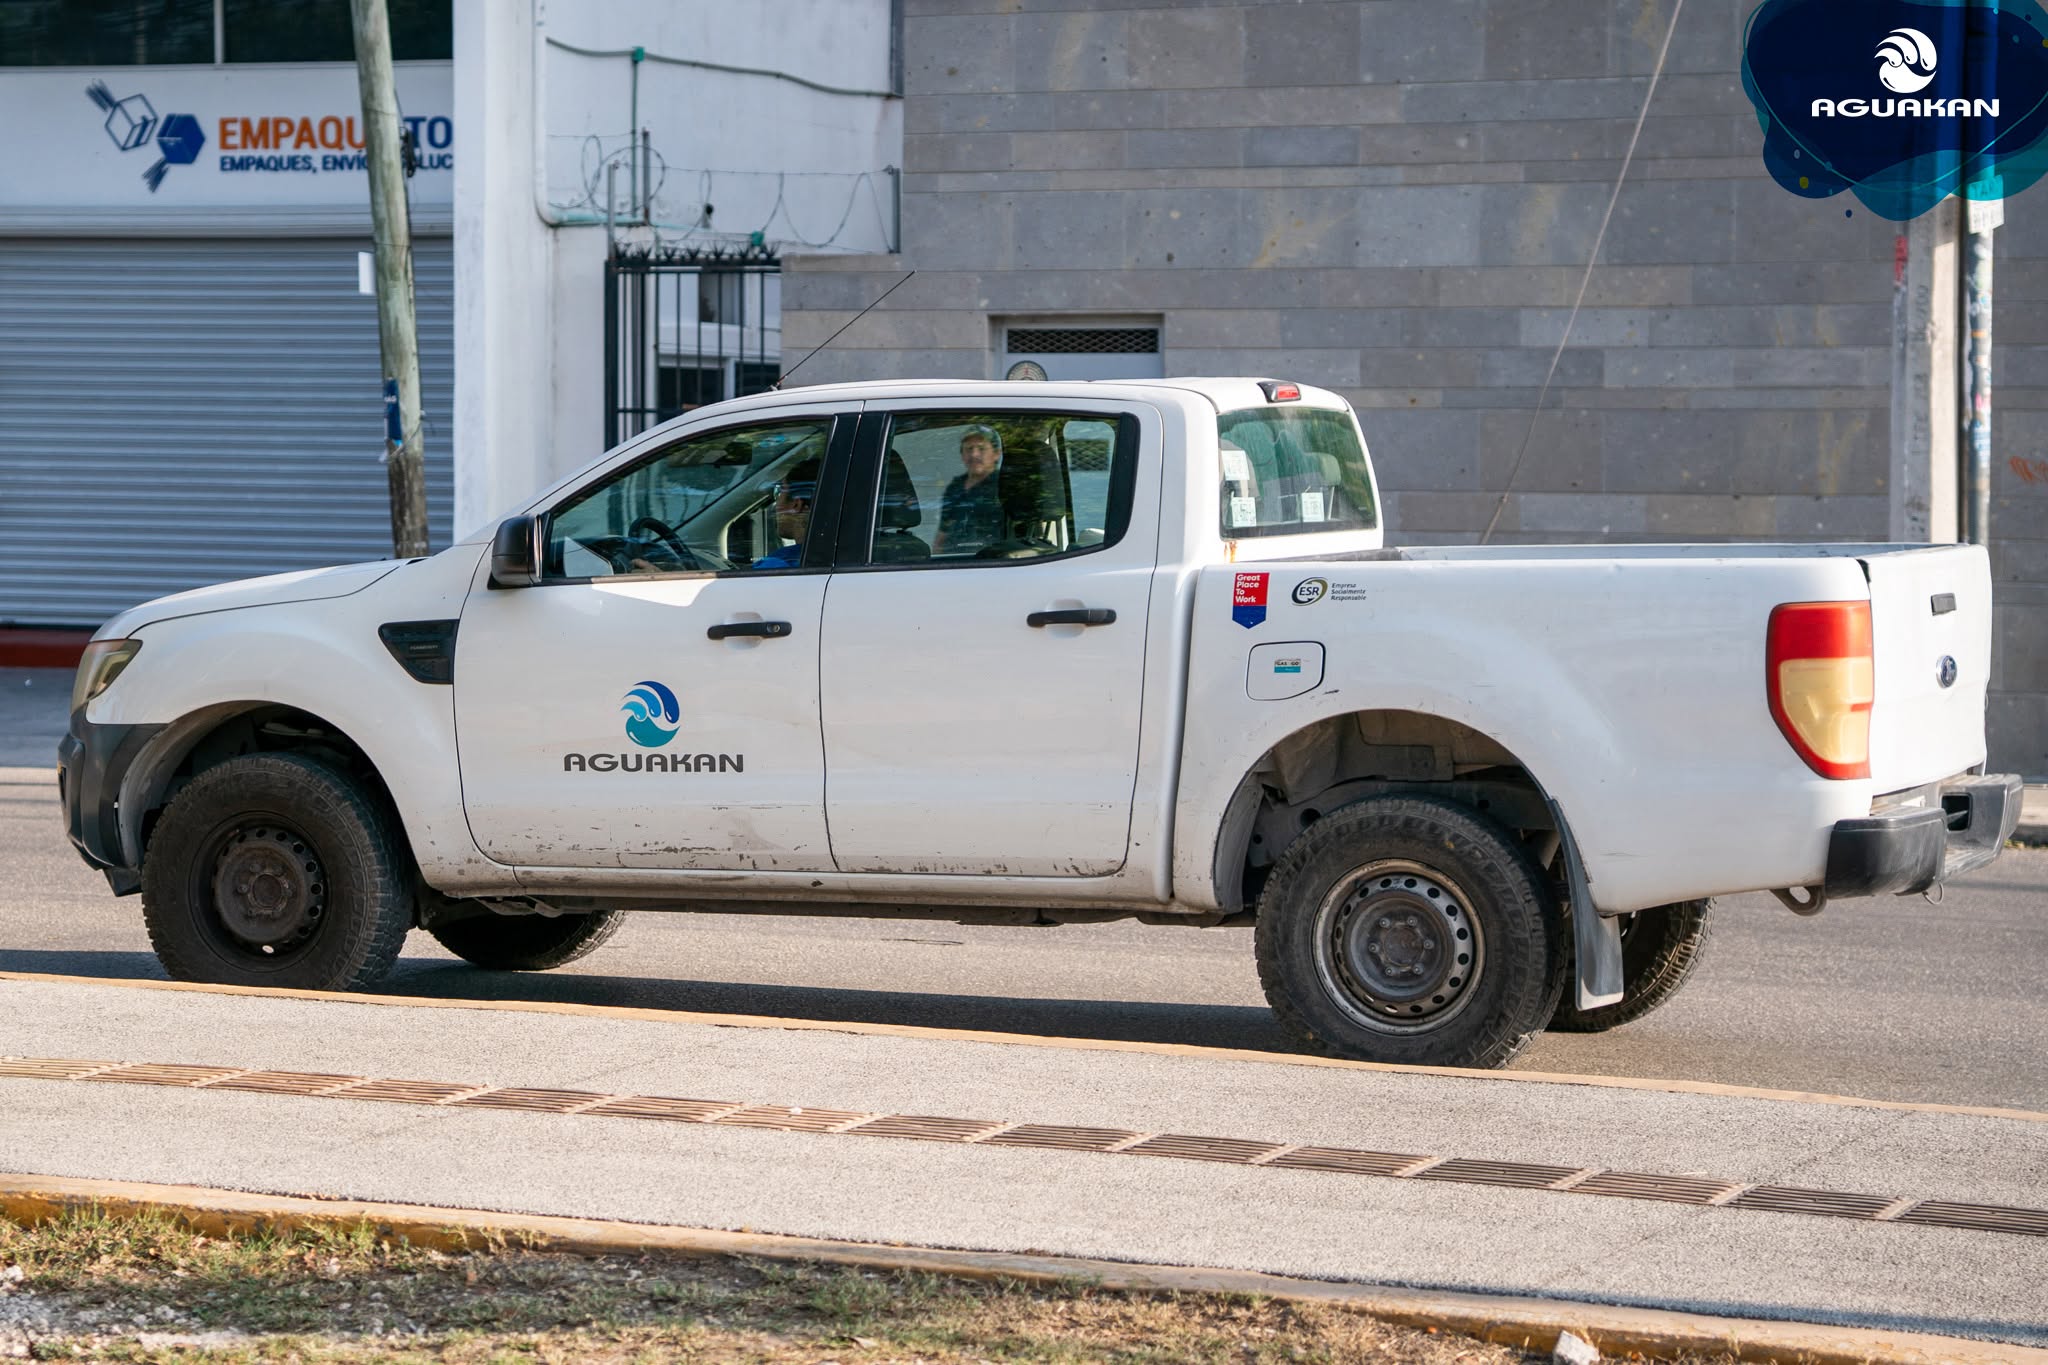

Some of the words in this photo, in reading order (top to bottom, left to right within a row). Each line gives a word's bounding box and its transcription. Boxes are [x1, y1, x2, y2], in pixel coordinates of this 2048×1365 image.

[219, 116, 367, 151] EMPAQU
[219, 155, 317, 173] EMPAQUES,
[1235, 595, 1257, 603] Work
[1299, 586, 1320, 596] ESR
[564, 753, 744, 773] AGUAKAN
